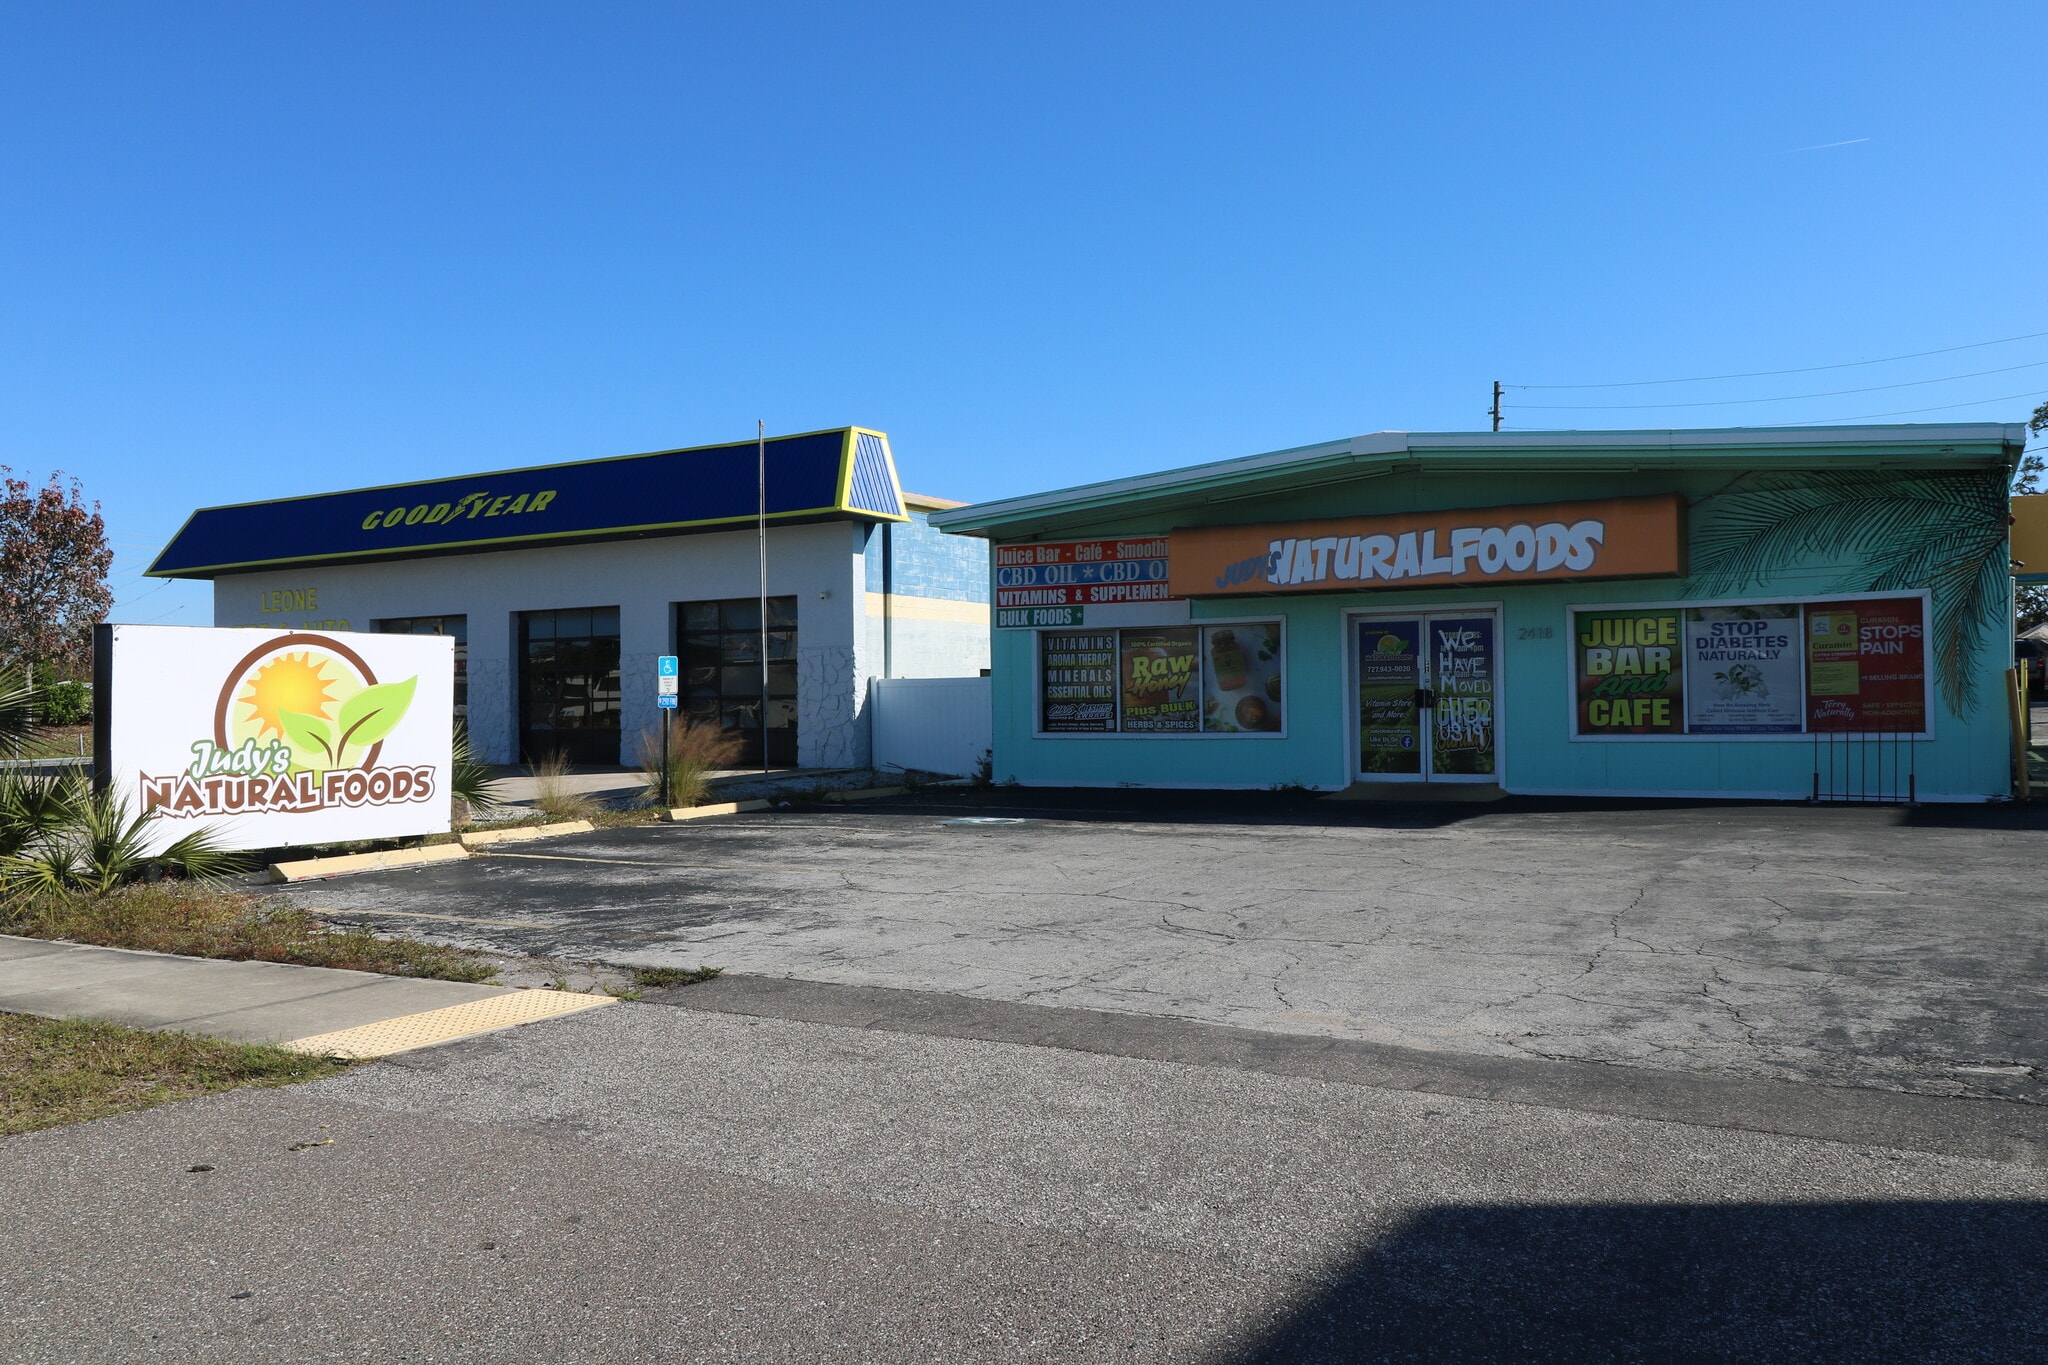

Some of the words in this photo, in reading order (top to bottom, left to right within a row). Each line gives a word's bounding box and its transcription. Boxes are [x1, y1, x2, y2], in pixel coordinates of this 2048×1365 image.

[998, 547, 1033, 565] Juice
[1036, 546, 1060, 563] Bar
[1074, 542, 1102, 561] Café
[1116, 539, 1168, 559] Smoothi
[998, 567, 1036, 586] CBD
[1044, 564, 1076, 584] OIL
[1099, 561, 1139, 582] CBD
[1147, 559, 1168, 580] OI
[261, 587, 318, 613] LEONE
[998, 588, 1066, 606] VITAMINS
[1075, 588, 1083, 602] &
[1090, 584, 1174, 602] SUPPLEMEN
[999, 608, 1028, 626] BULK
[1033, 608, 1071, 625] FOODS
[1580, 616, 1678, 647] JUICE
[1711, 621, 1768, 636] STOP
[1859, 625, 1922, 640] STOPS
[1047, 636, 1113, 650] VITAMINS
[1696, 635, 1788, 649] DIABETES
[1860, 641, 1903, 656] PAIN
[1048, 653, 1075, 666] AROMA
[1078, 653, 1112, 666] THERAPY
[1440, 652, 1487, 675] HAVE
[1586, 647, 1672, 676] BAR
[1698, 650, 1782, 661] NATURALLY
[1048, 669, 1112, 682] MINERALS
[1132, 655, 1194, 679] Raw
[1048, 685, 1091, 699] ESSENTIAL
[1093, 685, 1112, 698] OILS
[1125, 671, 1191, 699] Honey
[1441, 675, 1491, 694] MOVED
[1592, 670, 1668, 697] And
[1161, 702, 1195, 713] BULK
[1392, 698, 1412, 708] Store
[1588, 697, 1672, 727] CAFE
[1821, 699, 1847, 709] Terry
[1127, 720, 1153, 729] HERBS
[1165, 720, 1195, 729] SPICES
[188, 737, 291, 780] Judy's
[139, 768, 323, 820] NATURAL
[322, 764, 436, 808] FOODS
